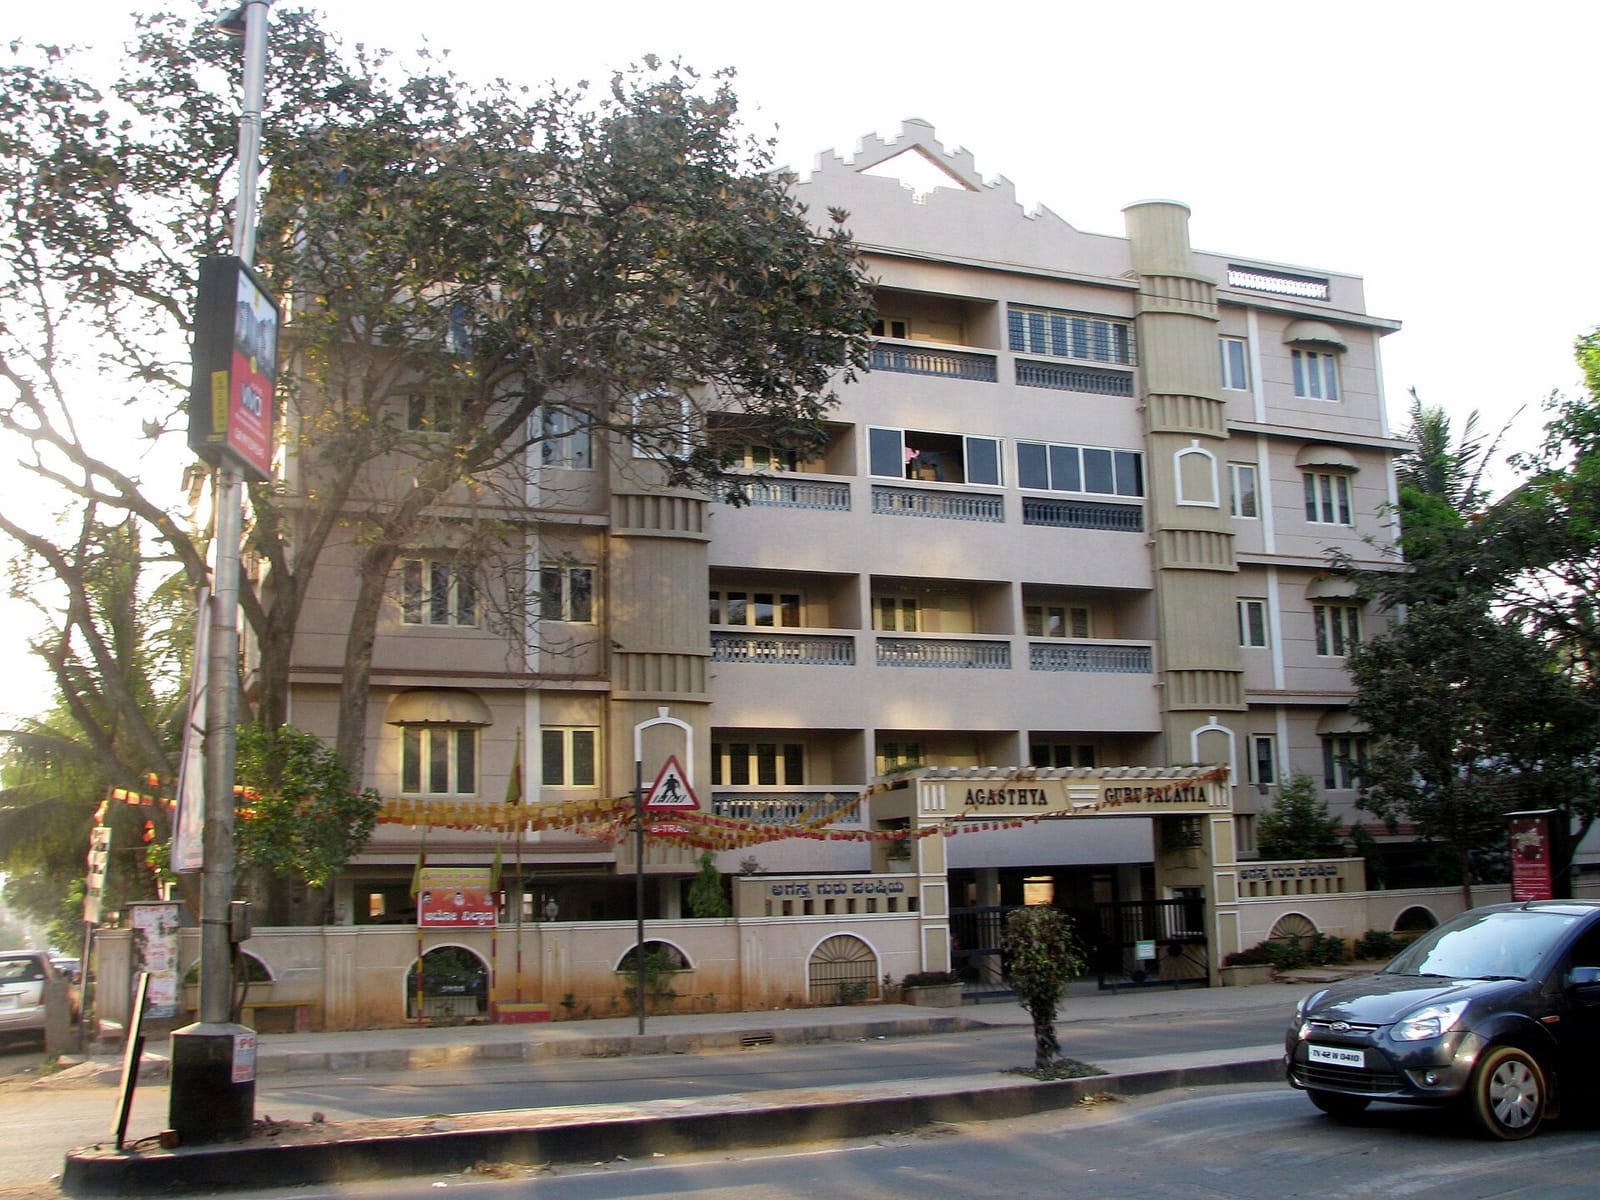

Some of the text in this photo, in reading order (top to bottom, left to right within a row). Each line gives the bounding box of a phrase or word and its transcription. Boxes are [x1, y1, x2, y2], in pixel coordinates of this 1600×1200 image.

[965, 786, 1207, 805] AGASTHYA GURU PALATIA
